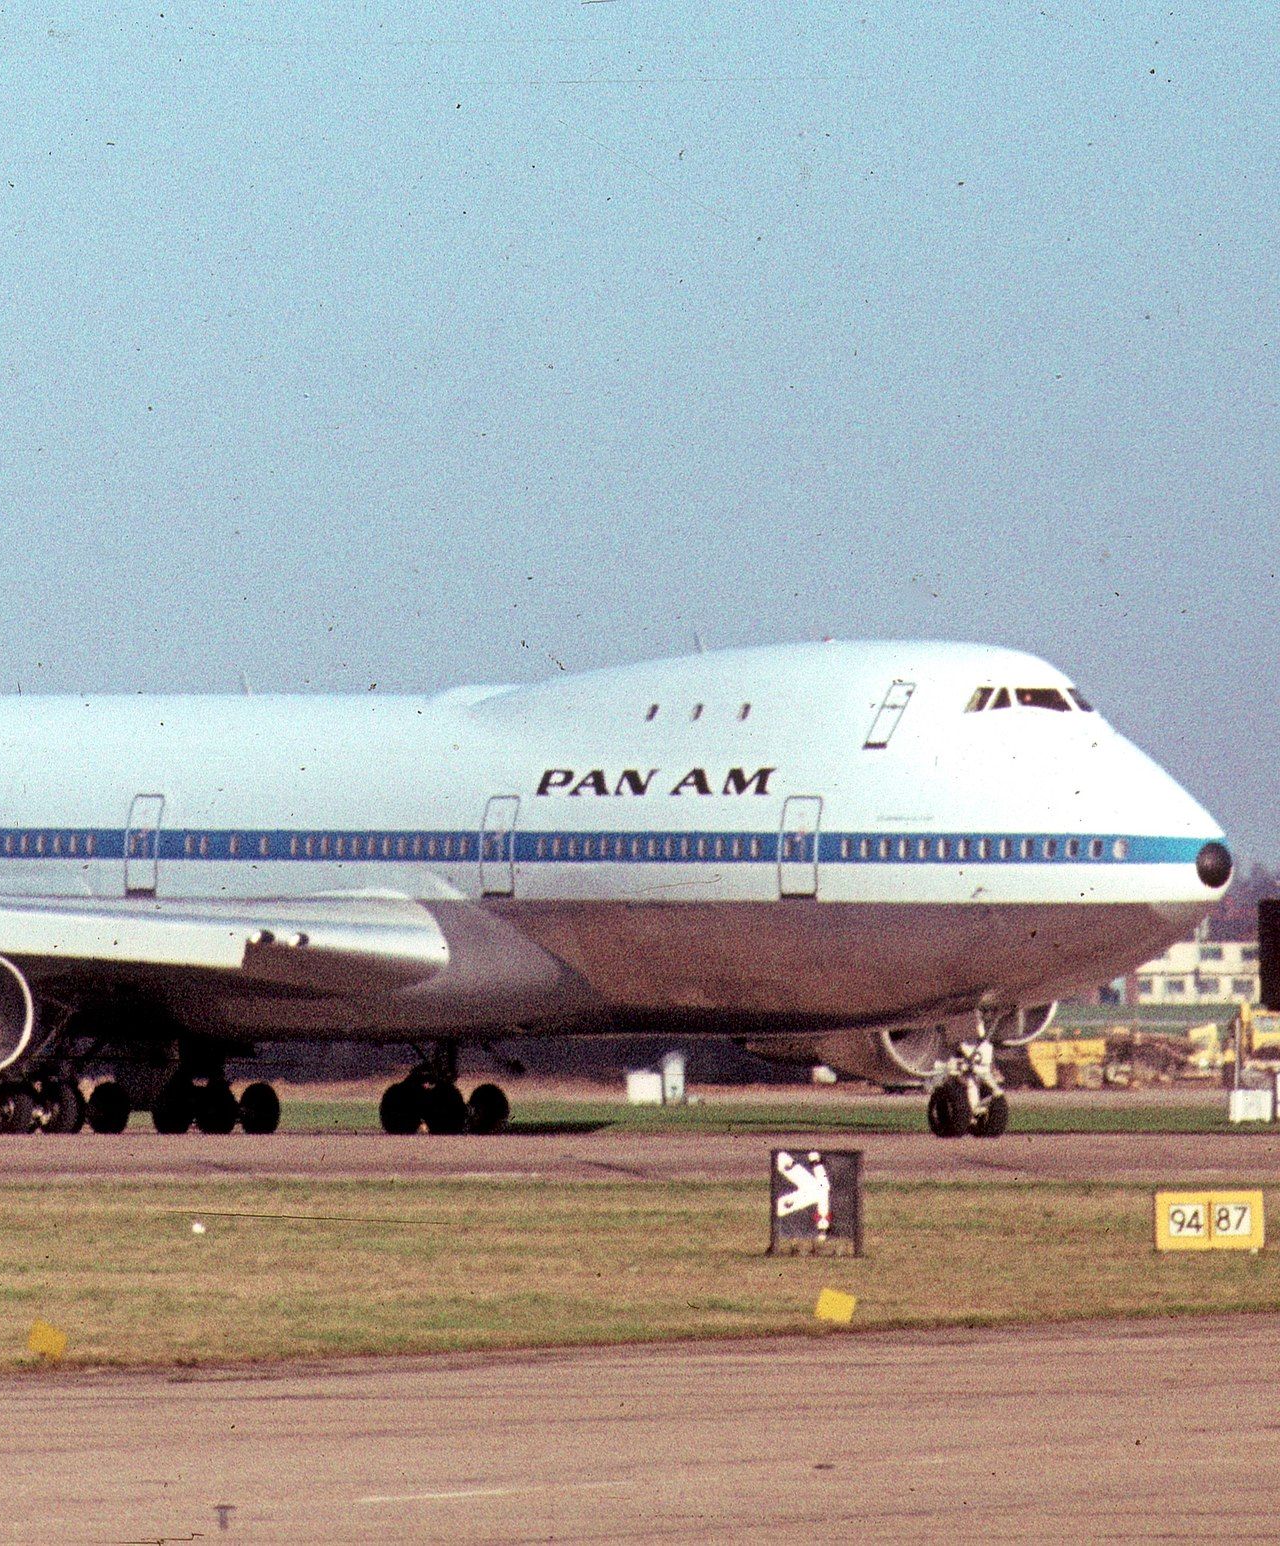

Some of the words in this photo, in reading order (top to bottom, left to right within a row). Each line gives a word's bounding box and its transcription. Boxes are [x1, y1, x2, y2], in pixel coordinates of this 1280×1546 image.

[536, 768, 659, 797] PAN
[669, 767, 777, 797] AM
[1170, 1209, 1203, 1233] 94
[1216, 1206, 1248, 1231] 87
